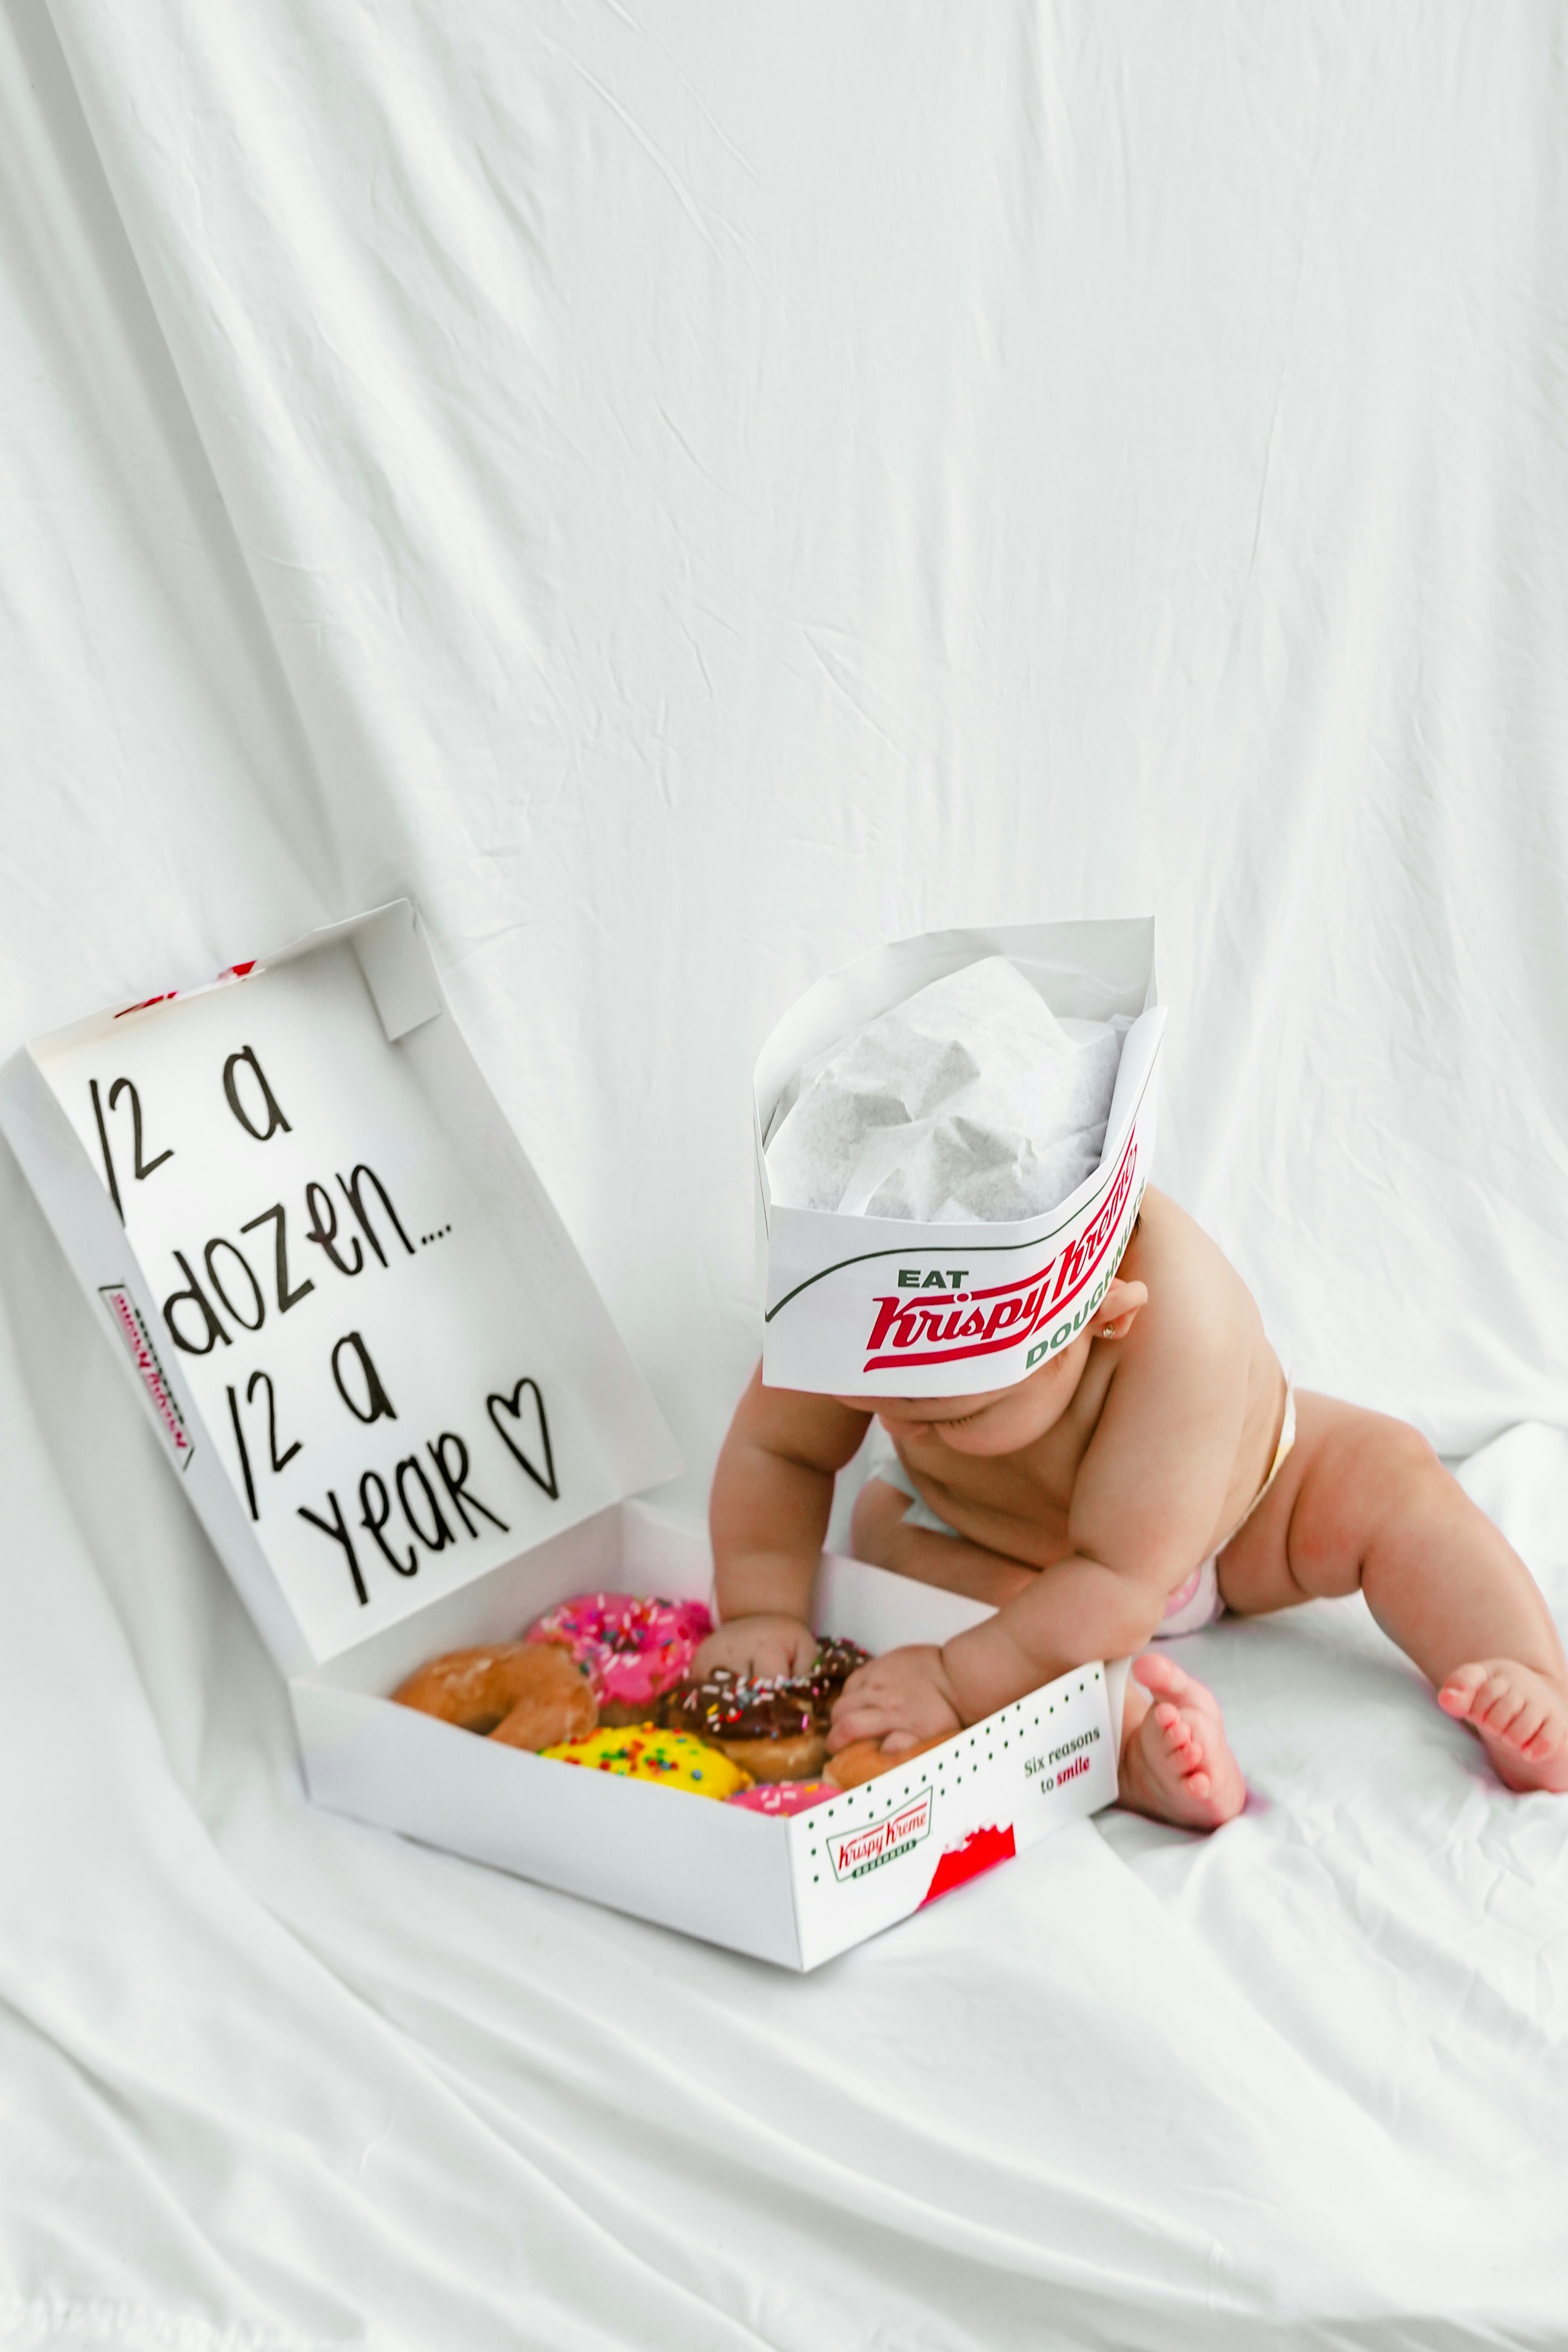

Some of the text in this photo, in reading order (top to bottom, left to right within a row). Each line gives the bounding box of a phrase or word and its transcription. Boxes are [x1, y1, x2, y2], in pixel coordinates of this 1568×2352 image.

[89, 1045, 292, 1227] 12 a
[864, 1120, 1138, 1372] Krispy Kreme
[898, 1269, 969, 1289] EAT
[1026, 1177, 1145, 1370] DOUGHNUTS
[226, 1371, 302, 1521] 12
[331, 1331, 398, 1424] a
[1024, 1726, 1100, 1779] Six reasons
[1041, 1756, 1090, 1794] to smile
[839, 1824, 884, 1871] Krispy
[886, 1801, 927, 1846] Kreme
